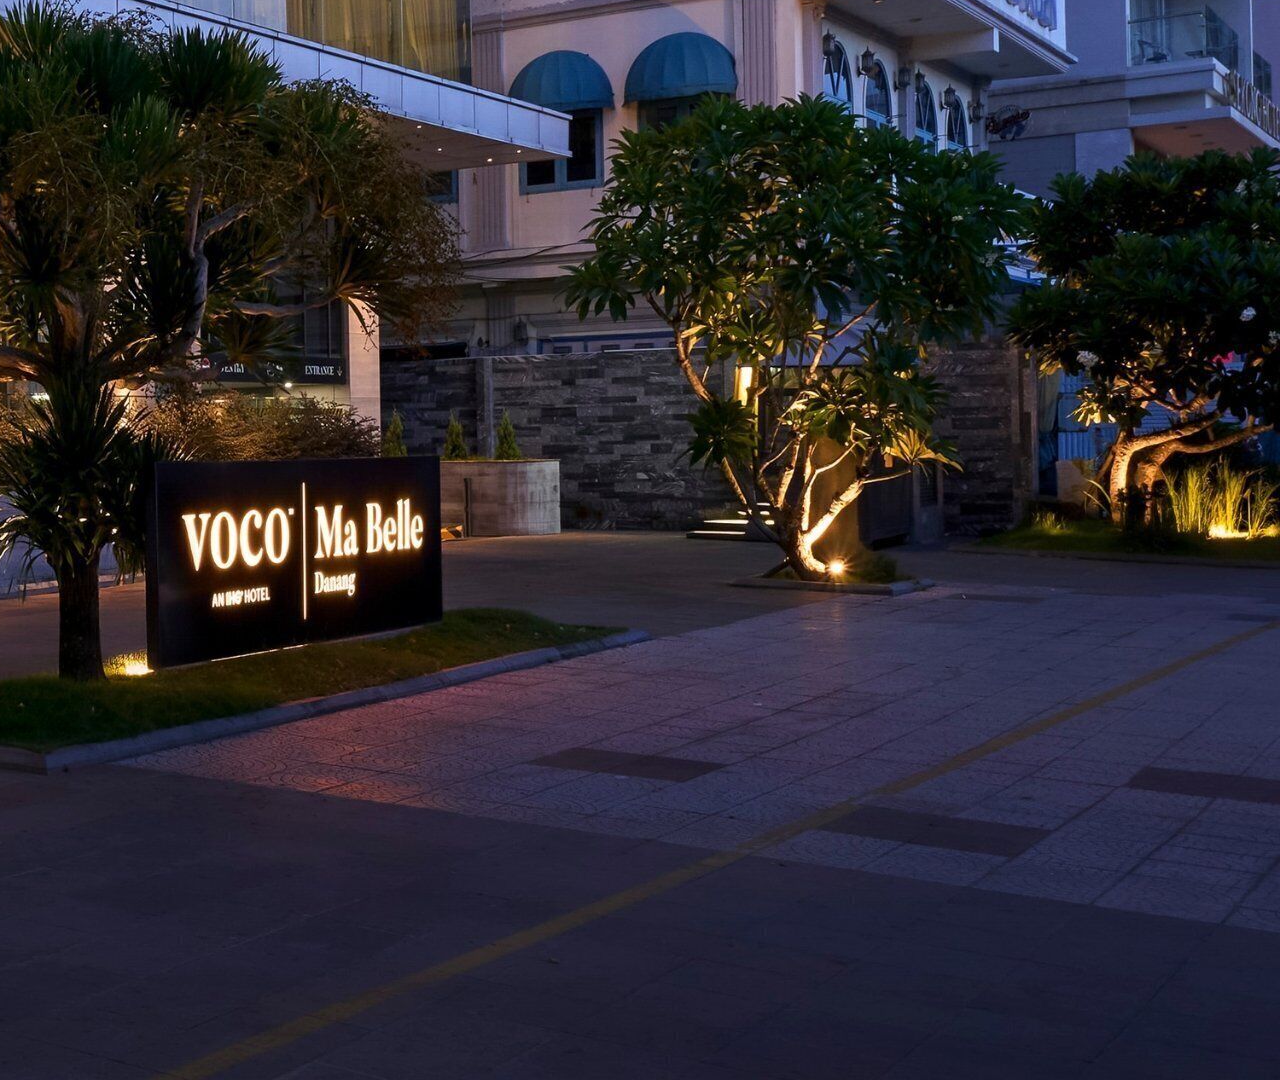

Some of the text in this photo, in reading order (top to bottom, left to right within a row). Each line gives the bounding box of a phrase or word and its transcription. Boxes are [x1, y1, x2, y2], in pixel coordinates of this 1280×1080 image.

[305, 365, 334, 376] ENTRANCE
[314, 505, 359, 559] Ma
[366, 498, 424, 553] Belle
[314, 571, 356, 597] Danang
[212, 590, 225, 607] AN
[244, 587, 271, 604] HOTEL
